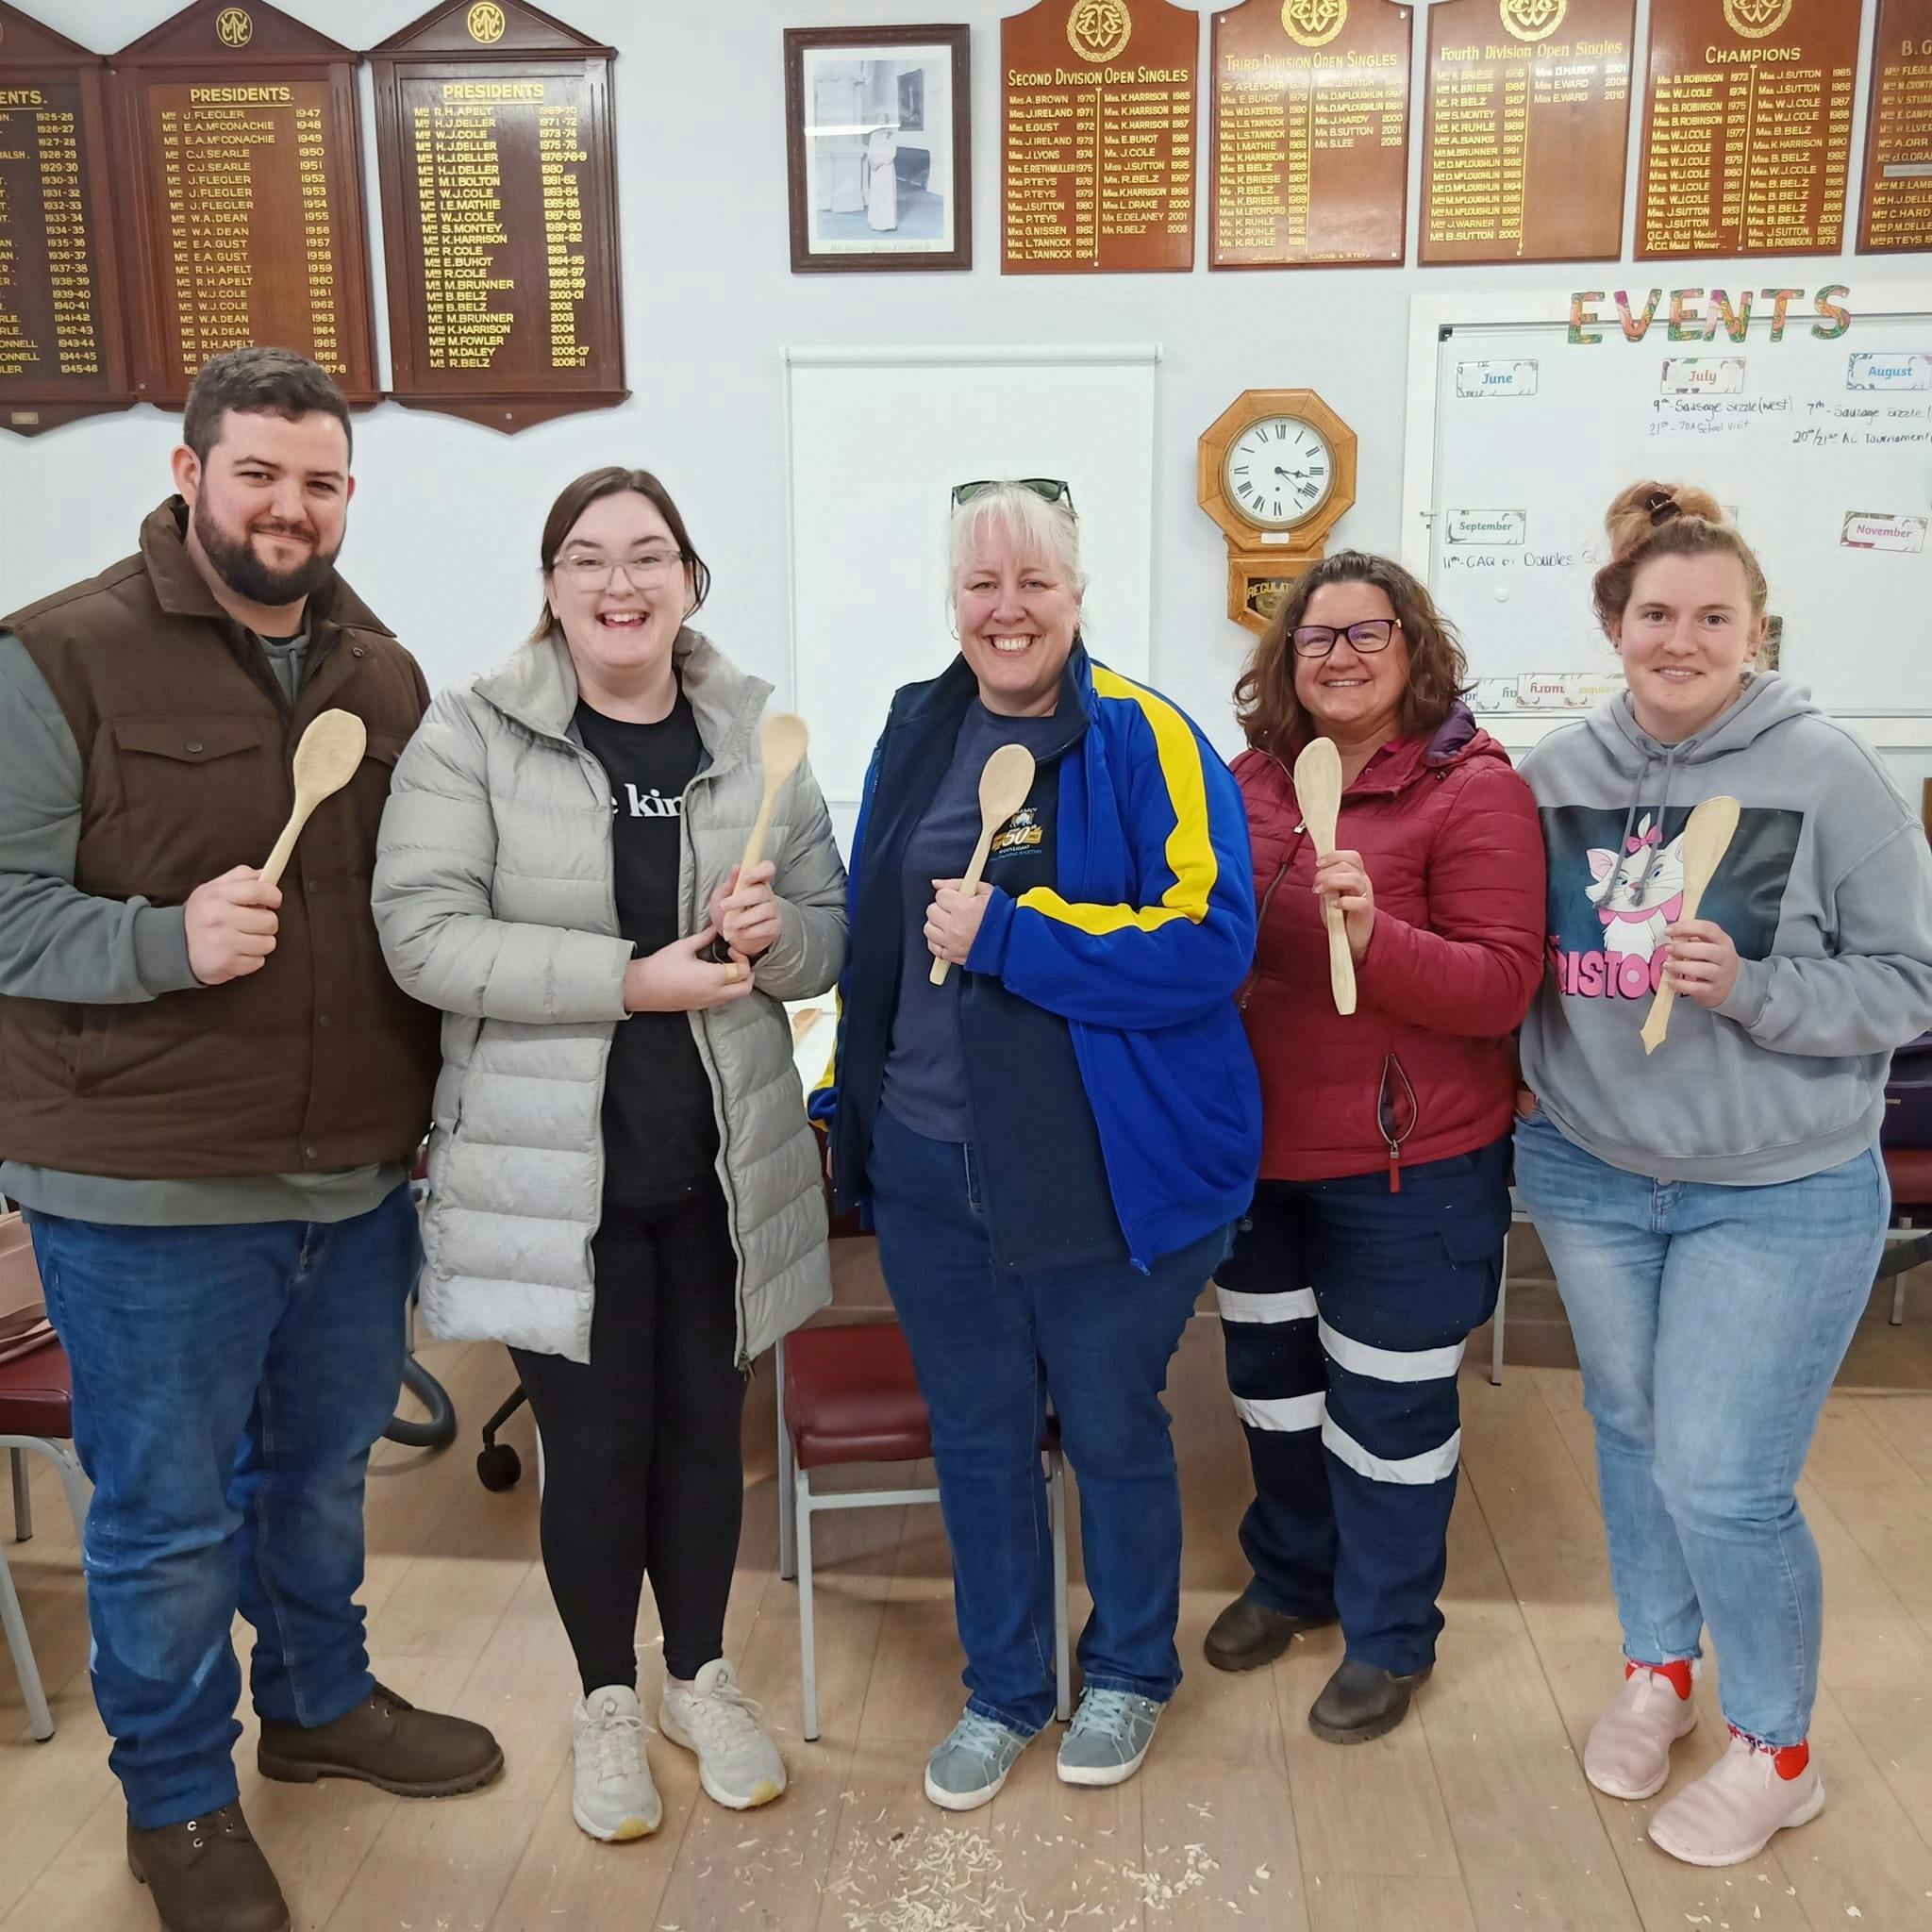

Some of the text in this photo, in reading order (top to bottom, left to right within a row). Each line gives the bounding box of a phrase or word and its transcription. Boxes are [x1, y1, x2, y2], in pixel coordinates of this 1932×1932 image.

[1441, 42, 1622, 61] Fourth Division Open Singles
[443, 84, 543, 100] PRESIDENTS
[1730, 87, 1747, 95] 1974
[295, 108, 321, 117] 1947
[1076, 108, 1093, 117] 1971
[297, 121, 322, 129] 1948
[1076, 123, 1094, 131] 1972
[1382, 126, 1402, 135] 2001
[1076, 137, 1093, 145] 1973
[299, 148, 325, 157] 1950
[1076, 150, 1093, 159] 1974
[300, 161, 323, 170] 1951
[542, 165, 563, 175] 1980
[302, 175, 325, 183] 1952
[1171, 175, 1190, 183] 1997
[302, 188, 326, 196] 1953
[304, 200, 327, 208] 1954
[1169, 200, 1190, 208] 2000
[305, 212, 329, 221] 1955
[441, 224, 503, 234] S.MONTEY
[307, 239, 330, 247] 1957
[442, 235, 508, 244] K.HARRISON
[308, 251, 331, 260] 1958
[442, 247, 483, 256] R.COLE
[443, 258, 493, 267] E.BUHOT
[308, 264, 333, 273] 1959
[444, 270, 487, 278] R.COLE
[309, 276, 333, 285] 1960
[444, 280, 514, 290] M.BRUNNER
[445, 291, 487, 301] B.BELZ
[446, 303, 487, 312] B.BELZ
[447, 313, 575, 323] M.BRUNNER 2003
[1568, 285, 1851, 344] EVENTS
[313, 326, 336, 335] 1964
[447, 325, 575, 334] K.HARRISON 2004
[448, 336, 575, 346] M.FOWLER 2005
[449, 348, 495, 358] M.DALEY
[450, 359, 491, 368] R.BELZ
[1689, 370, 1716, 384] July
[1868, 366, 1913, 379] August
[1482, 374, 1513, 384] June
[1459, 522, 1513, 532] September
[1857, 525, 1912, 538] November
[1003, 826, 1030, 846] 50
